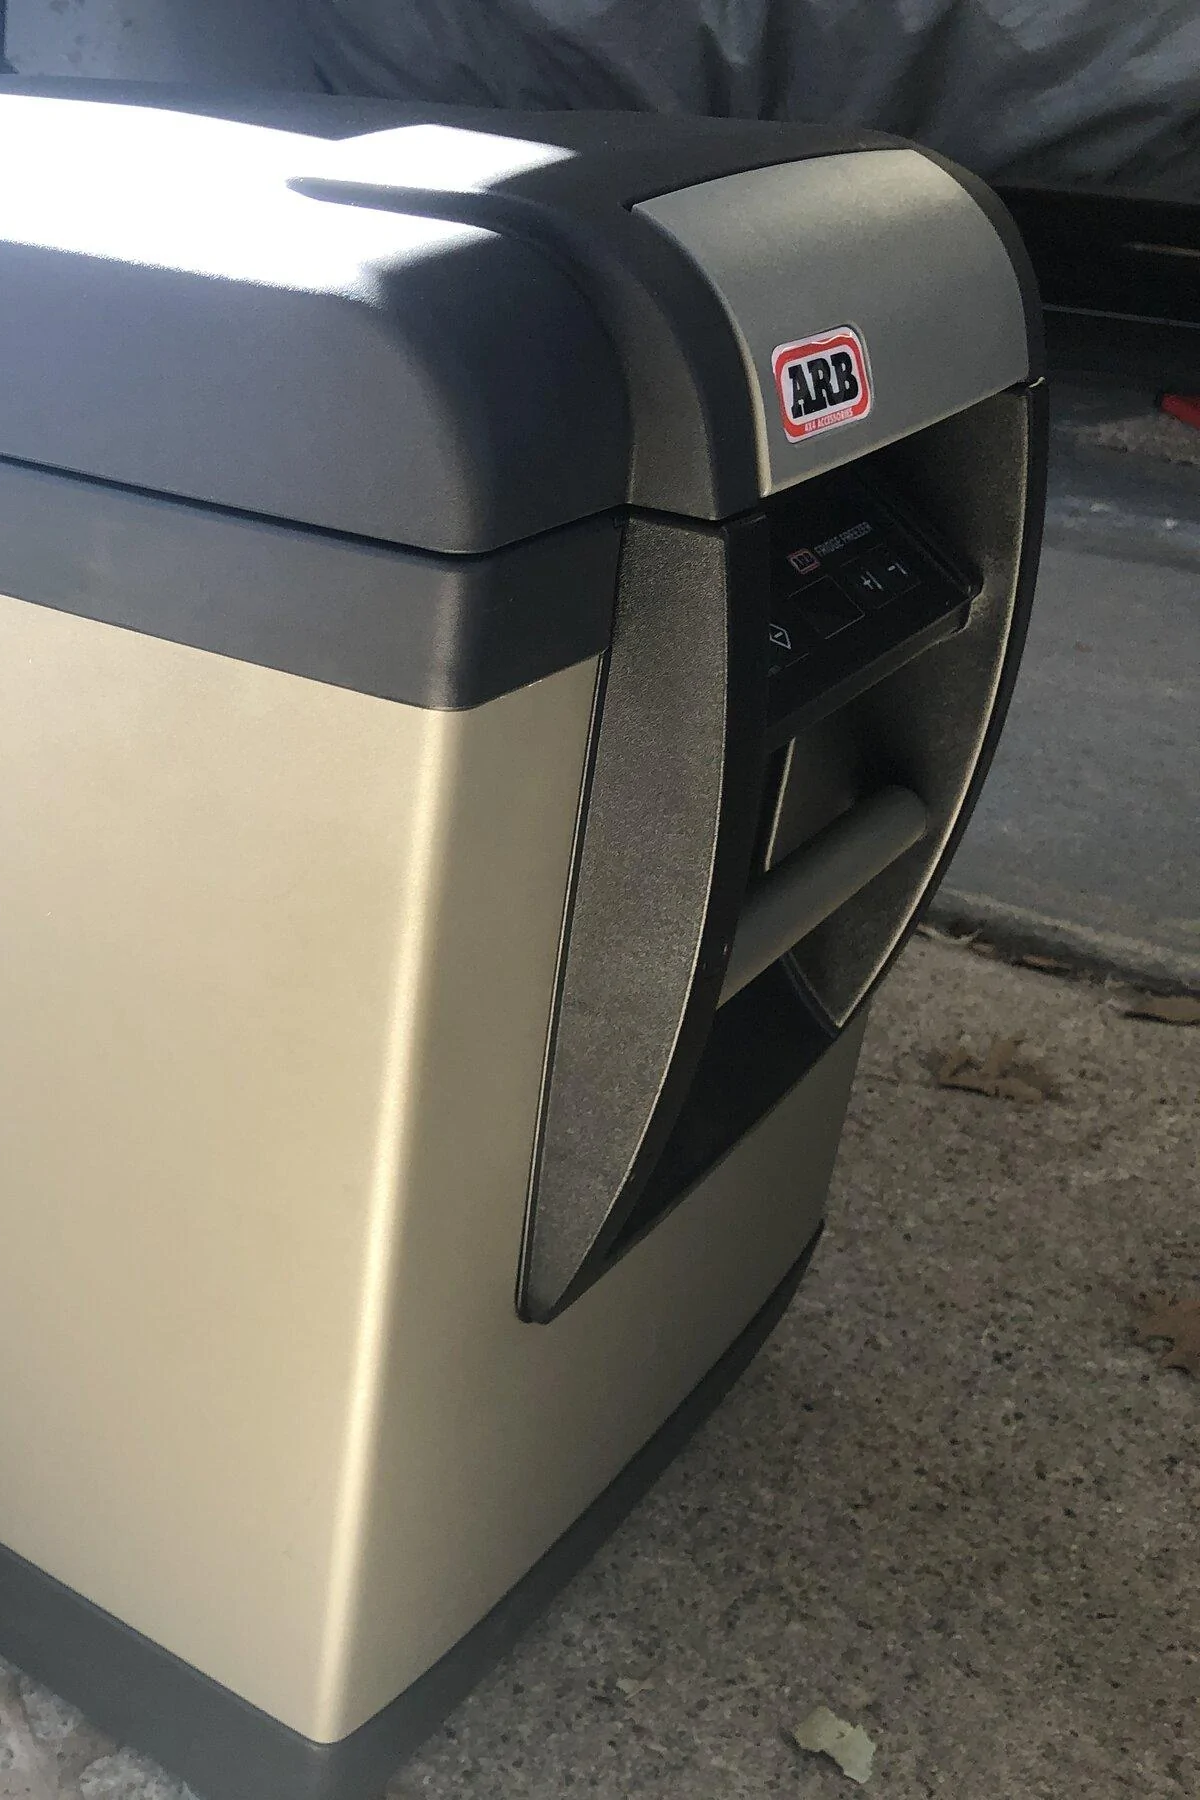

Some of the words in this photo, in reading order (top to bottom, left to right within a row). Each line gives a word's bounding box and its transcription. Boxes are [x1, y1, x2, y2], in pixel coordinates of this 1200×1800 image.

[788, 352, 859, 419] ARB
[817, 407, 854, 428] ACCESSORIES
[813, 536, 844, 557] FRIDGE
[839, 521, 872, 543] FREEZER
